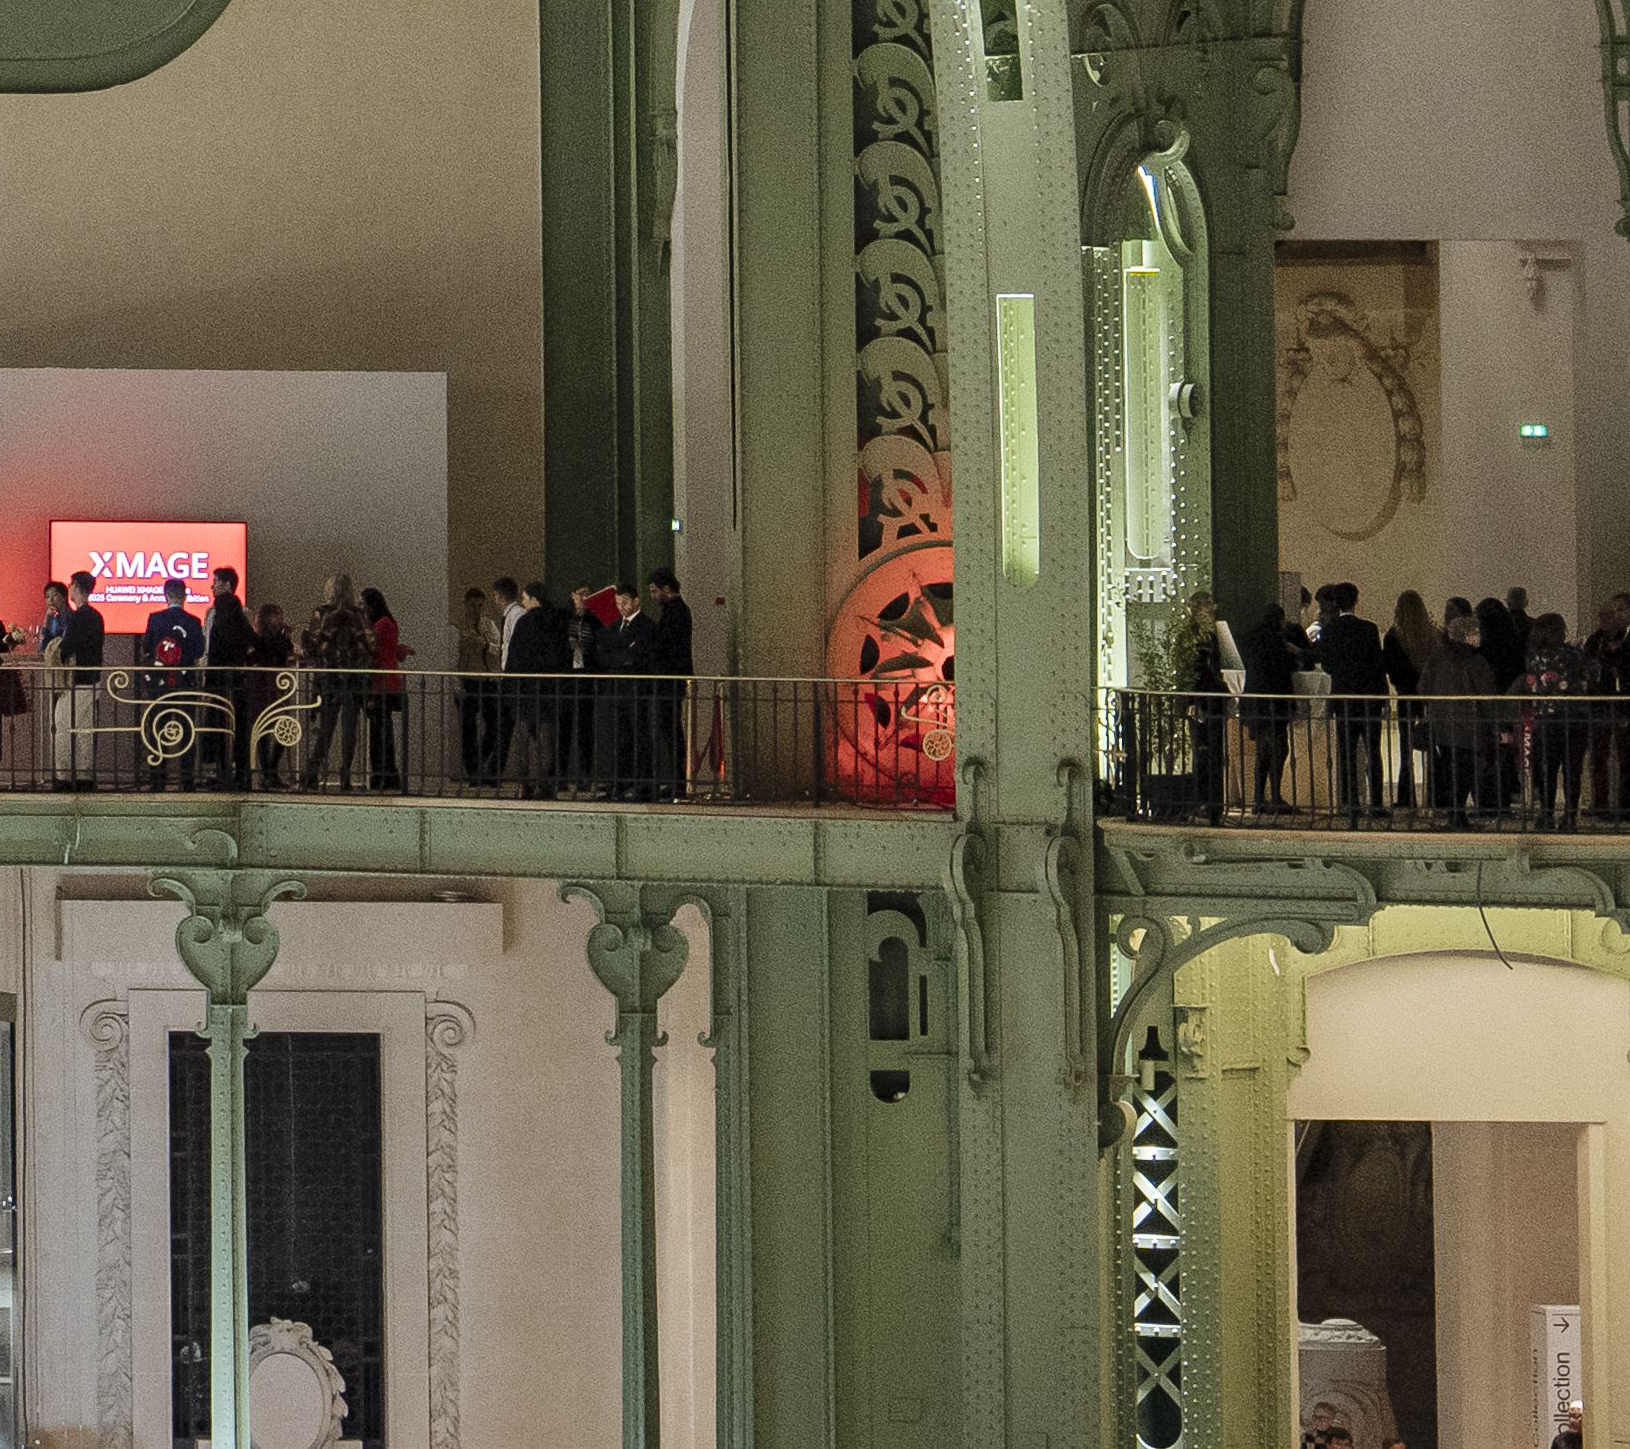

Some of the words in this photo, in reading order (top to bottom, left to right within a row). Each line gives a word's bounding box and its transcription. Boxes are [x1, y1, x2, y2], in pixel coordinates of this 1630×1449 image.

[88, 551, 209, 579] XMAGE
[106, 585, 136, 594] HUAWEI
[106, 594, 142, 604] Ceremony
[1552, 1352, 1571, 1435] ollection
